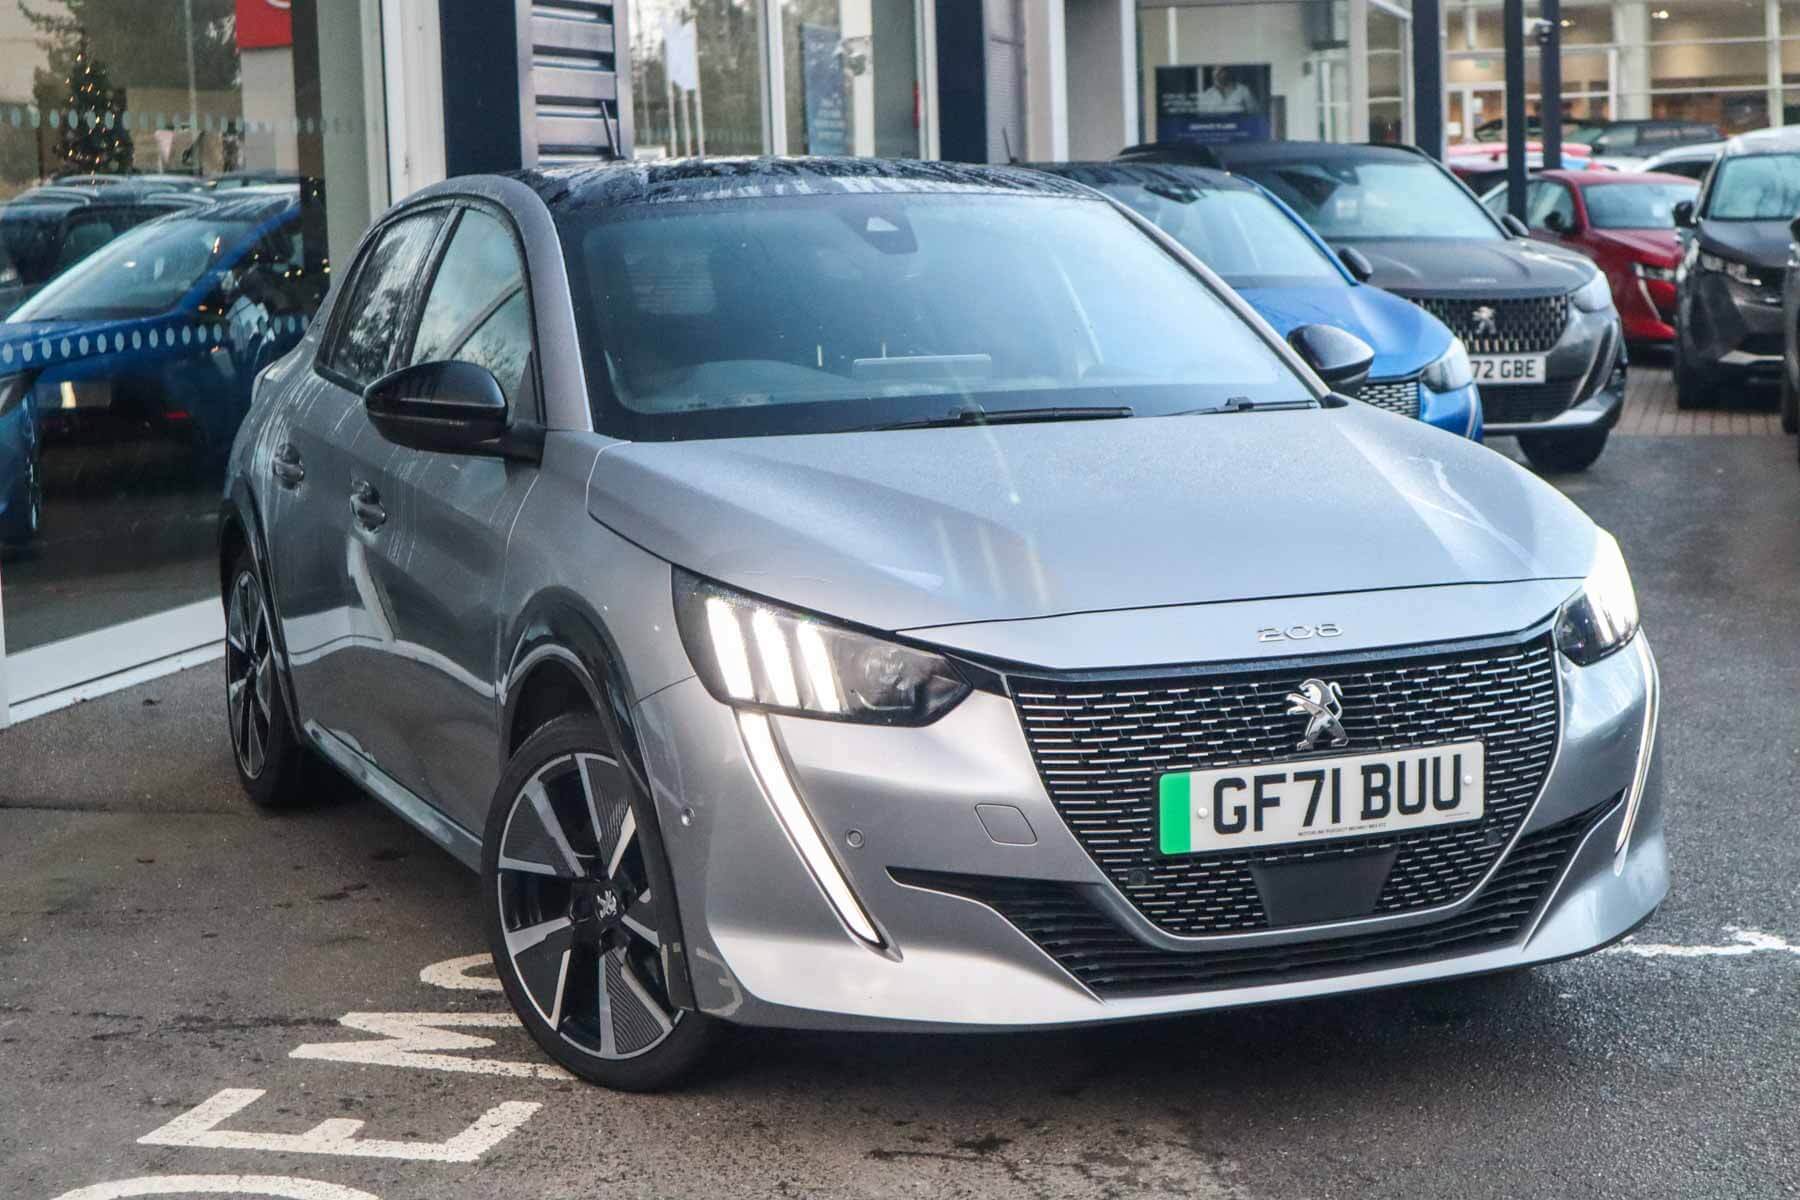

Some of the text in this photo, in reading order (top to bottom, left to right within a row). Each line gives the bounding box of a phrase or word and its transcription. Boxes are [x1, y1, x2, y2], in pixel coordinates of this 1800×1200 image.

[1500, 359, 1536, 378] GBE
[1257, 623, 1344, 642] 208
[1213, 754, 1462, 834] GF71 BUU
[49, 952, 578, 1200] EM
